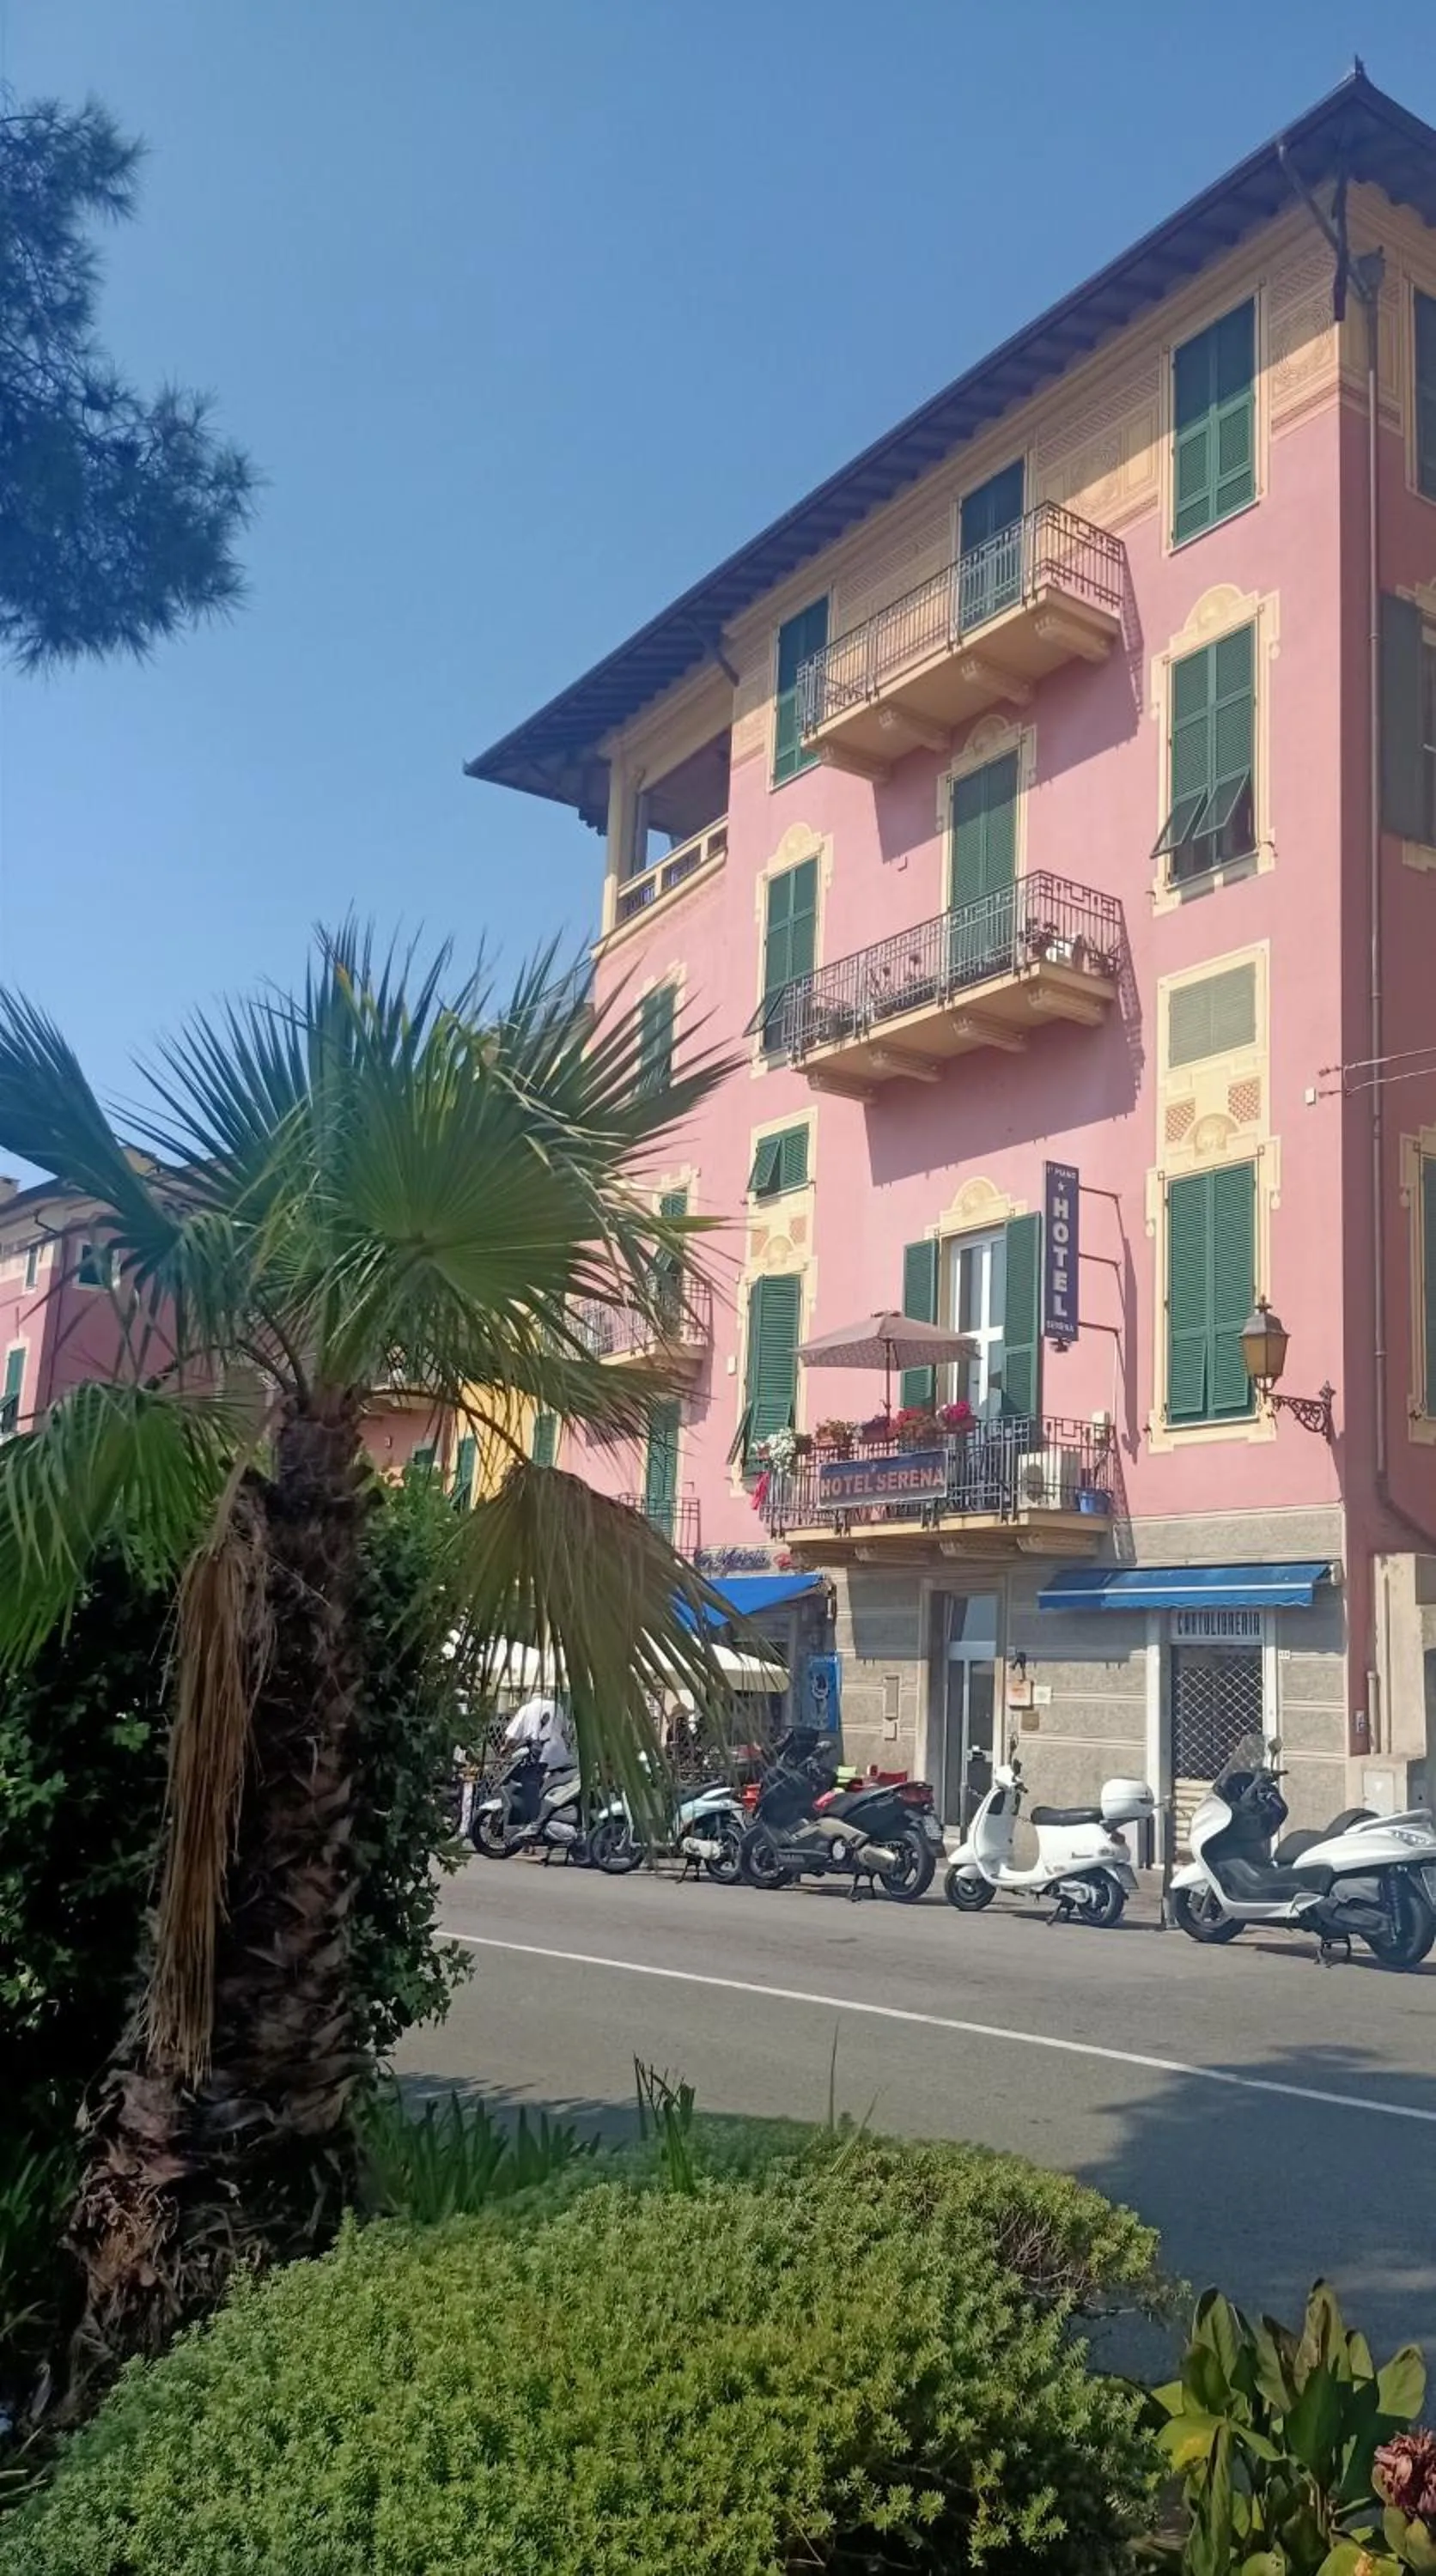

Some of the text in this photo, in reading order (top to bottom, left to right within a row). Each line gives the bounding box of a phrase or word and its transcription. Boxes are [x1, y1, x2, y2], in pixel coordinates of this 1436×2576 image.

[1052, 1197, 1068, 1316] HOTEL
[821, 1466, 944, 1498] HOTEL SERENA
[1177, 1611, 1260, 1636] CARTOLIBRERIA
